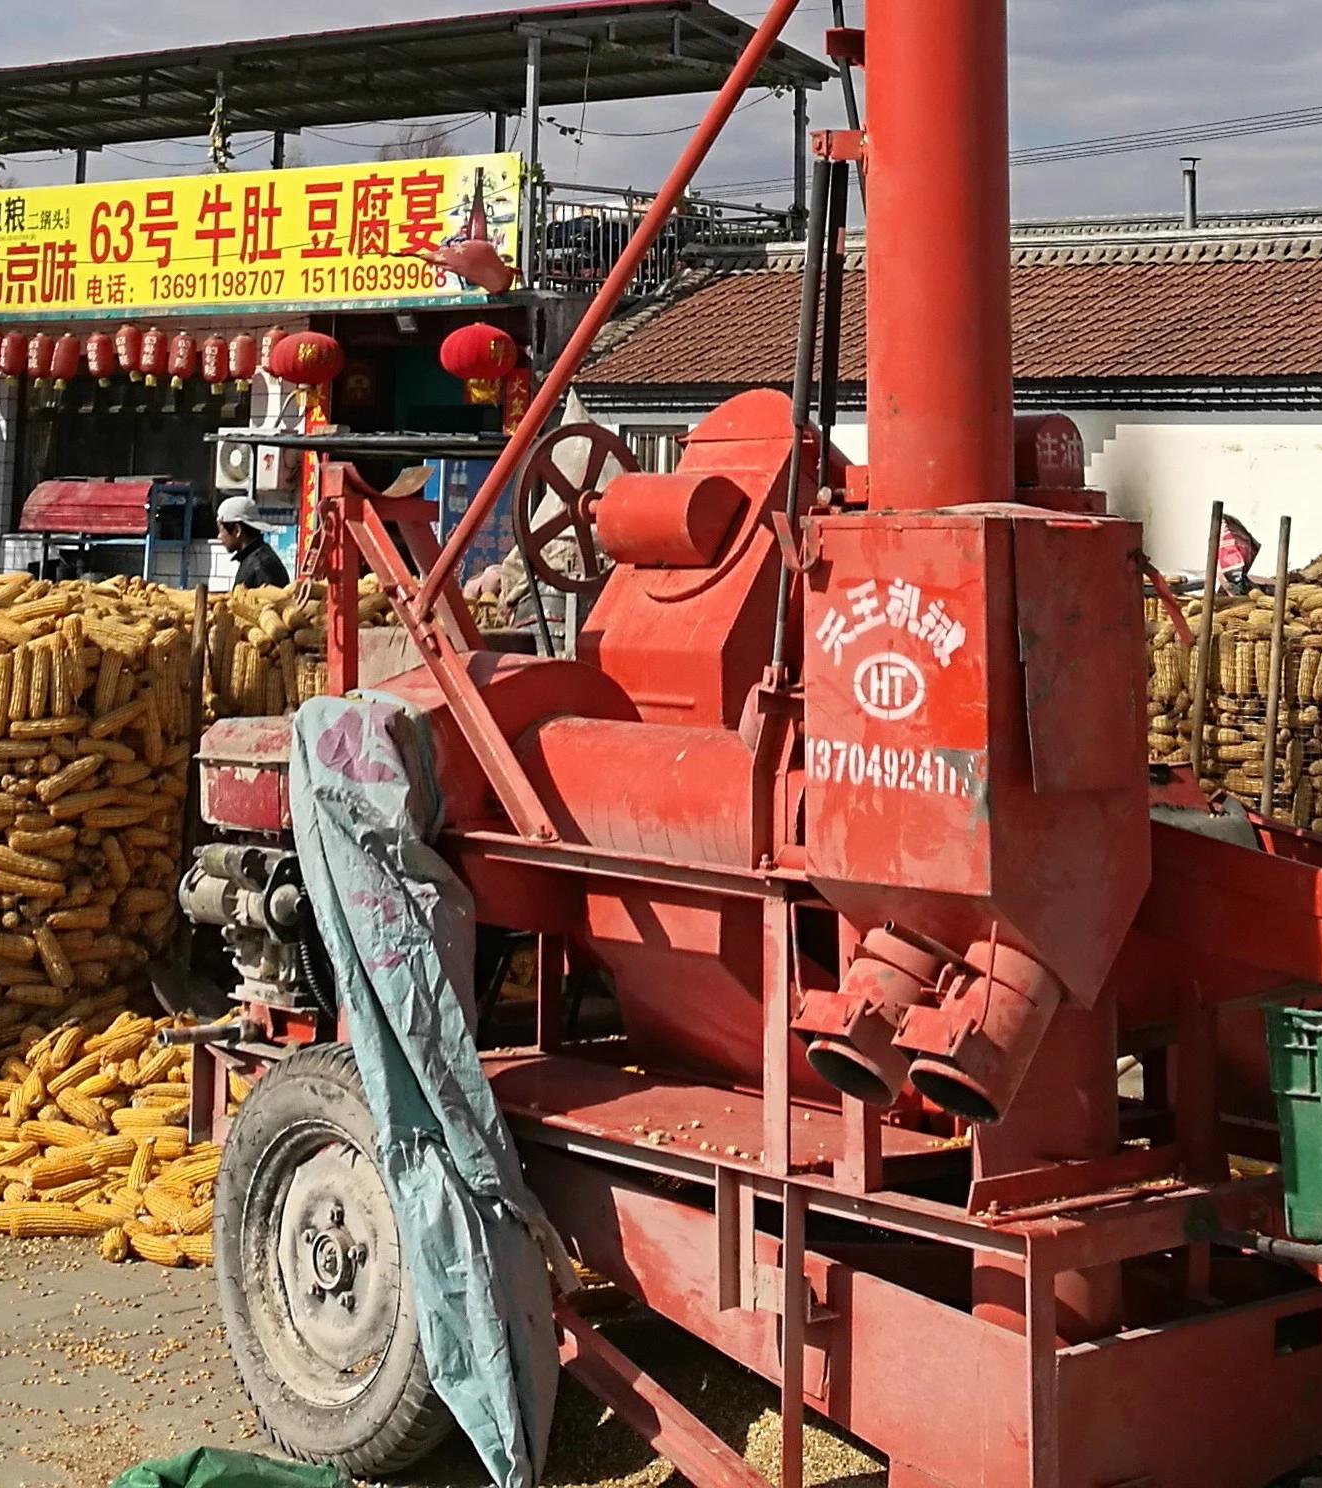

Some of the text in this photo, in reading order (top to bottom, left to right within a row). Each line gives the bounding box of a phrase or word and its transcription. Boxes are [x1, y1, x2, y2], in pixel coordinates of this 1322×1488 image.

[90, 169, 445, 269] 63号 牛肚 豆腐宴
[150, 269, 285, 300] 13691198707
[301, 263, 447, 293] 15116939968
[868, 664, 909, 708] HT
[805, 737, 975, 798] 137049241
